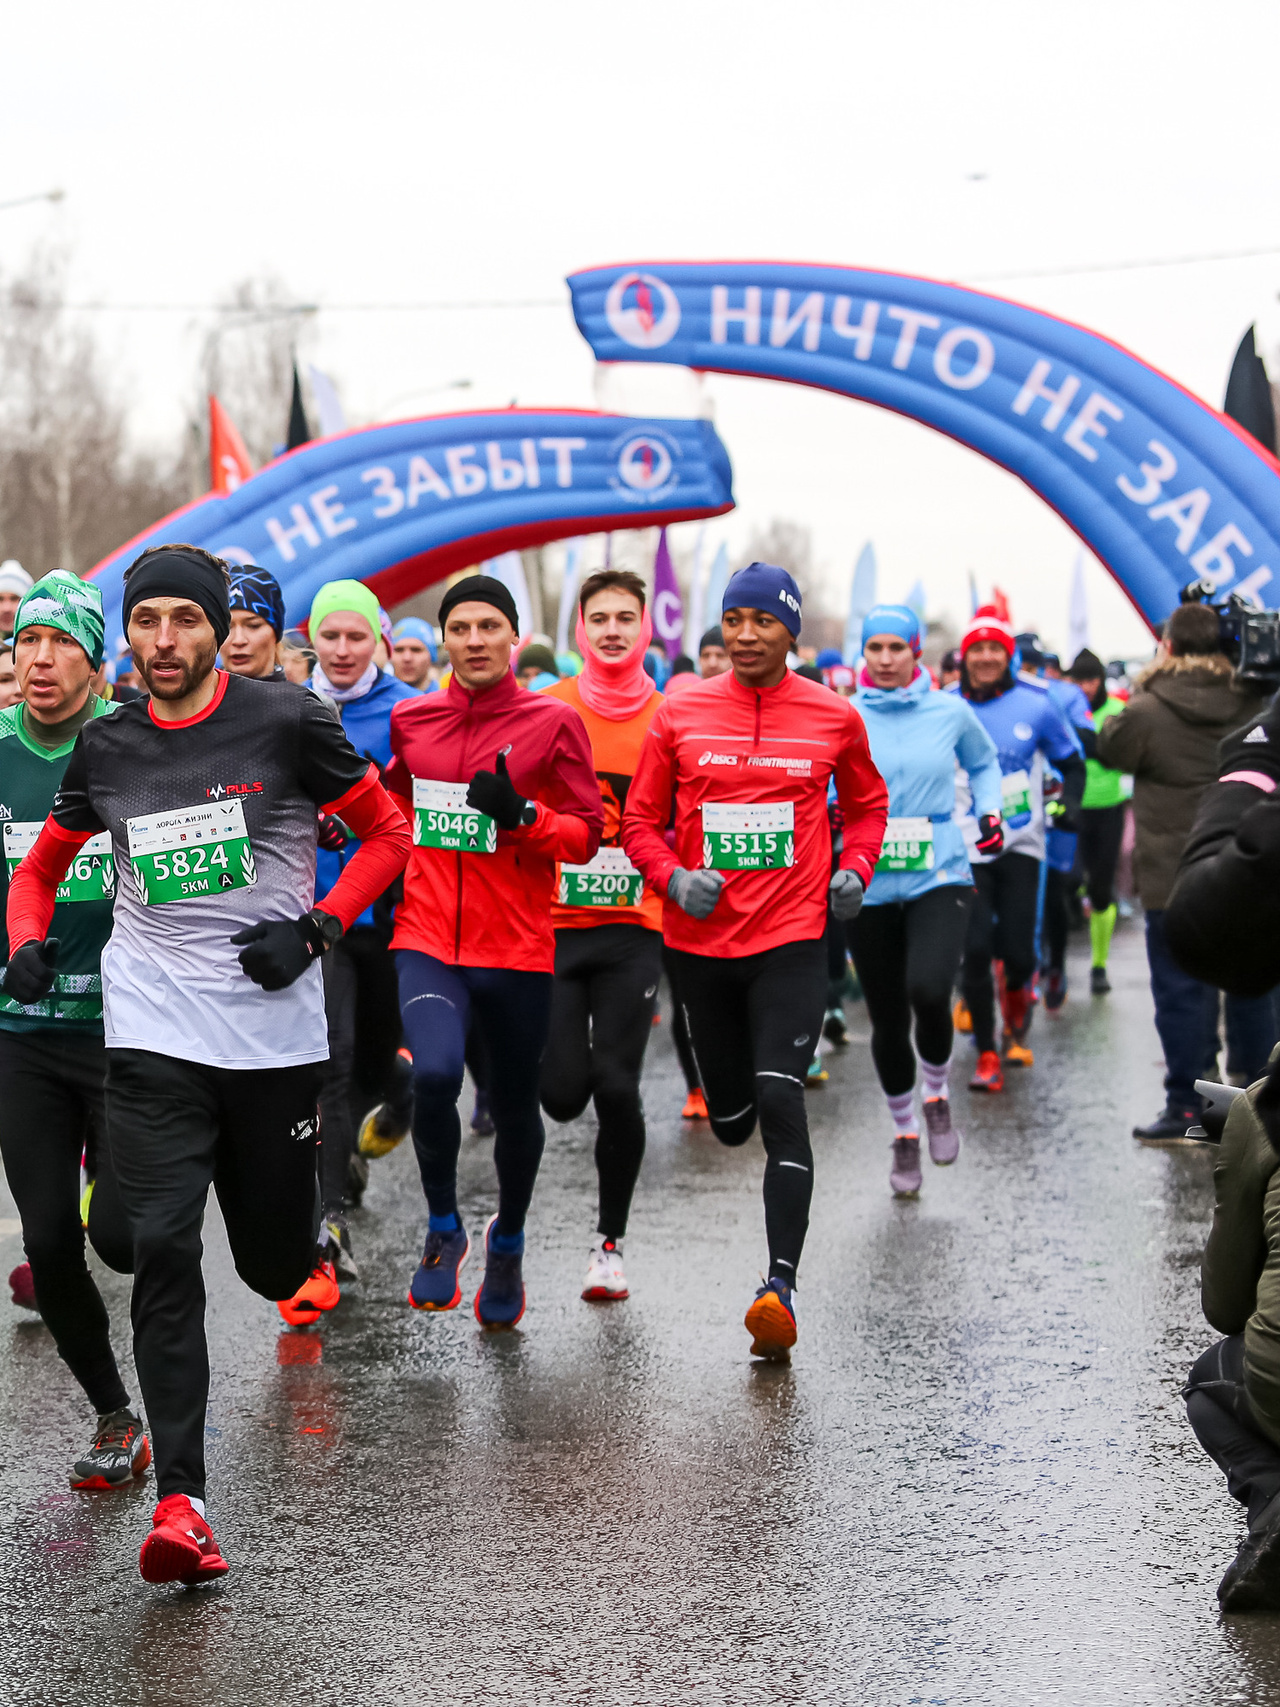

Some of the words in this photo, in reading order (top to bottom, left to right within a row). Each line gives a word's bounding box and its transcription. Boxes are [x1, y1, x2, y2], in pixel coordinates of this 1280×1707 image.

[710, 285, 996, 391] НИЧТО
[1011, 359, 1124, 463] НЕ
[265, 484, 358, 563] НЕ
[360, 437, 587, 520] ЗАБЫТ
[747, 756, 812, 769] FRONTRUNNER
[428, 811, 479, 836] 5046
[720, 834, 777, 854] 5515
[879, 842, 921, 859] 488
[152, 843, 229, 881] 5824
[576, 874, 630, 894] 5200
